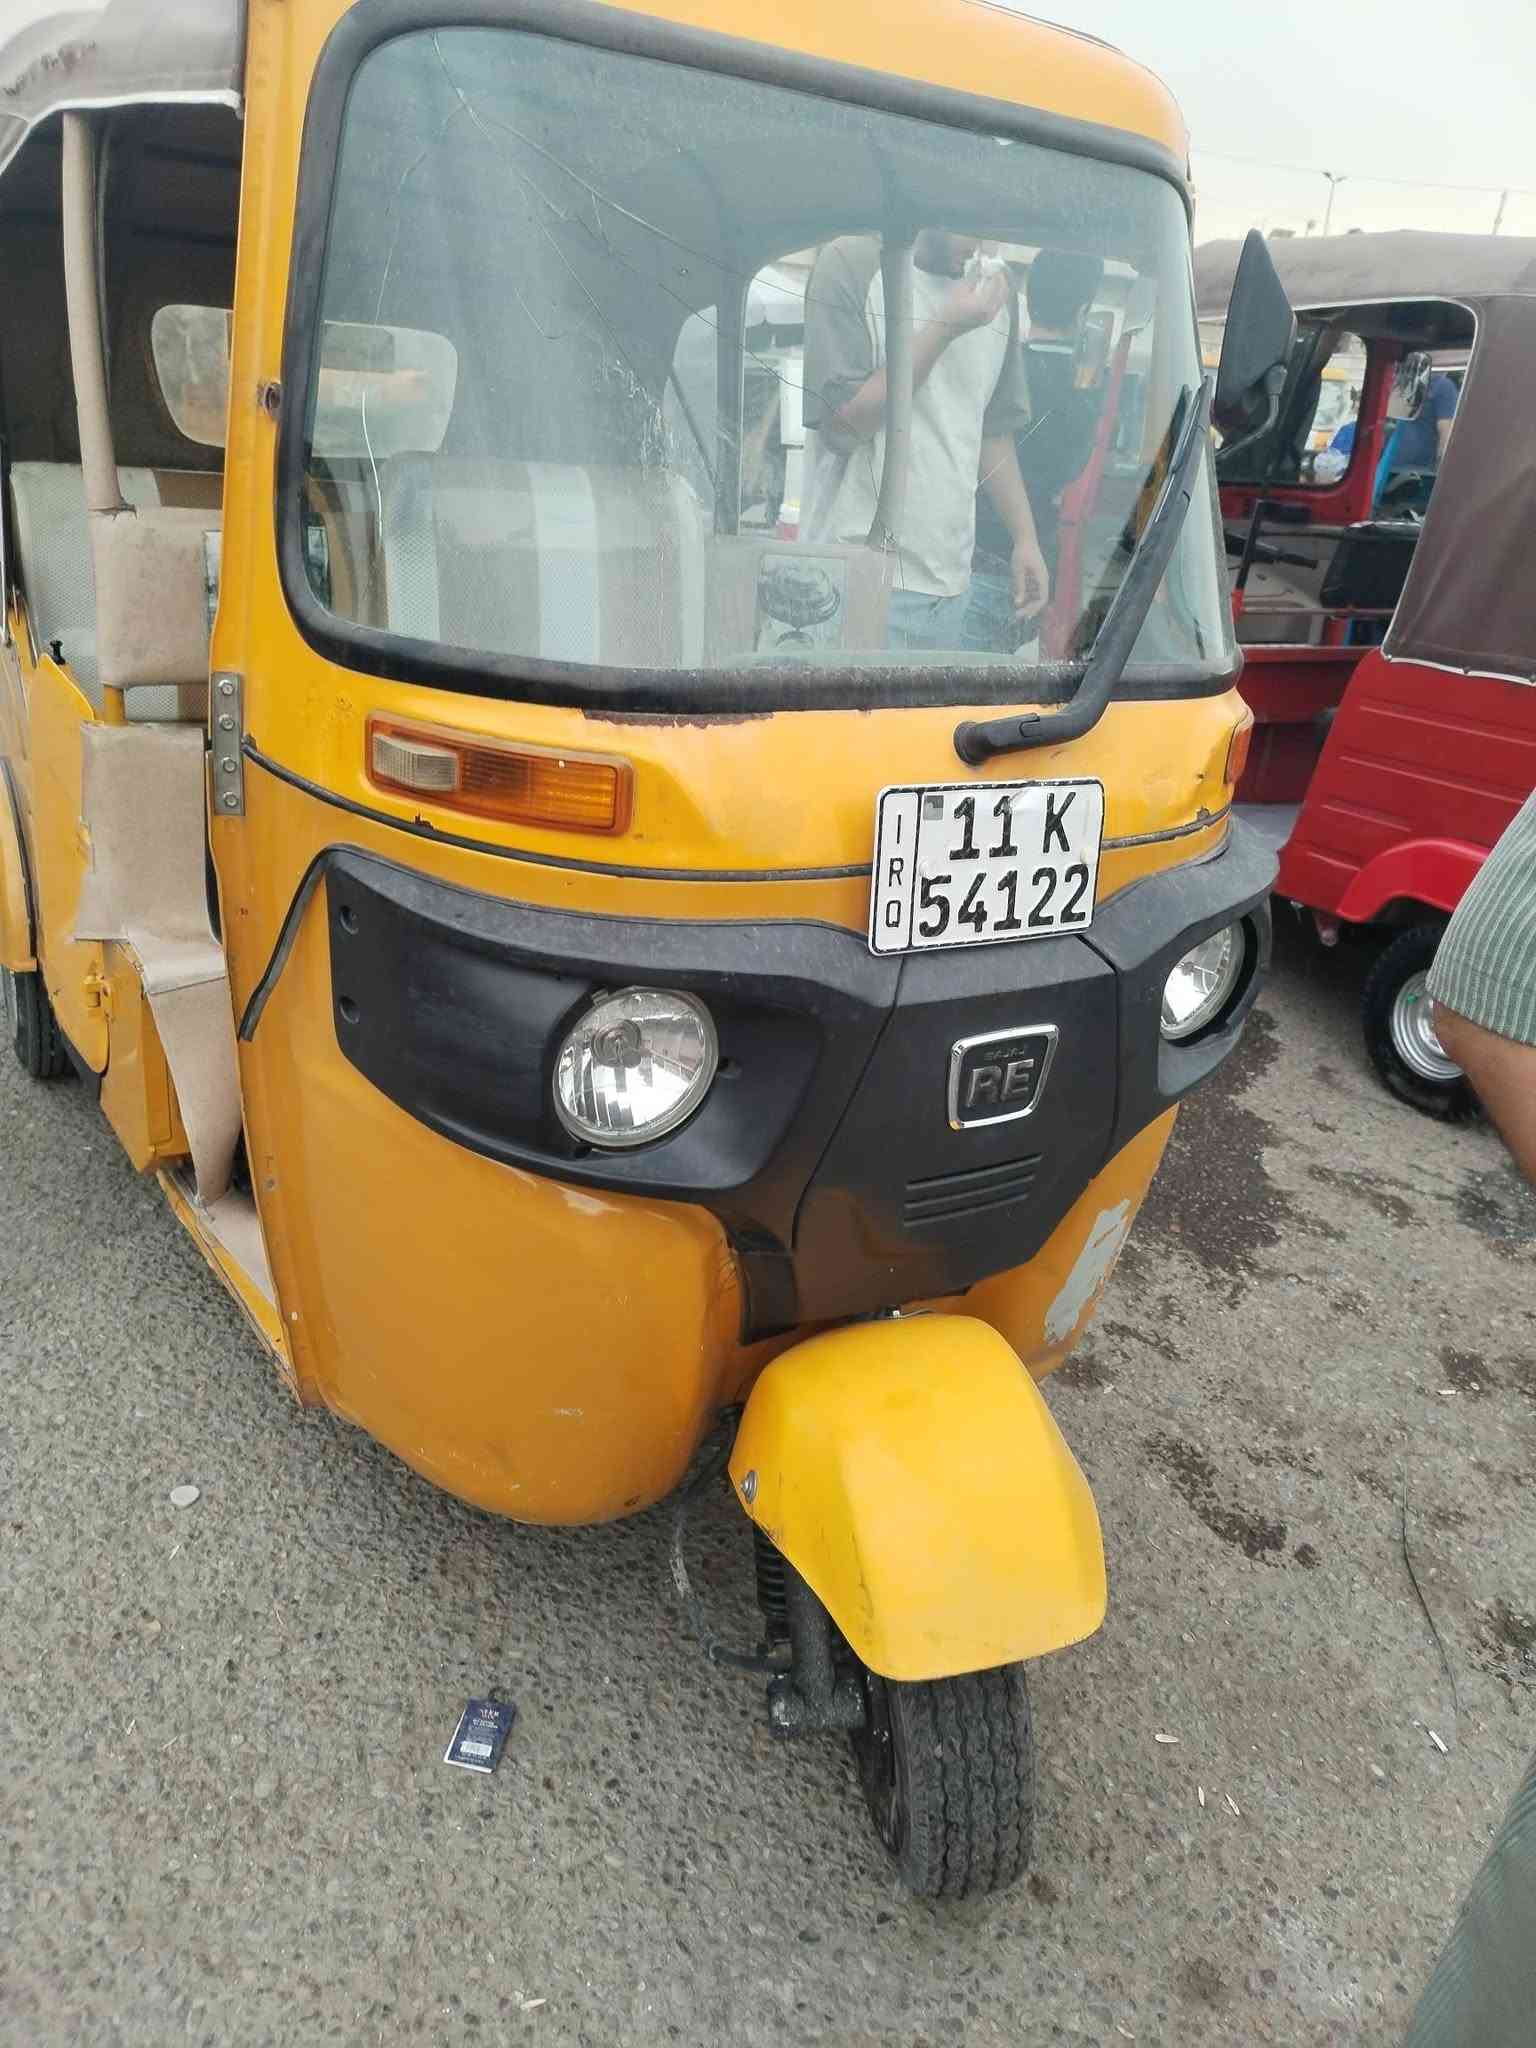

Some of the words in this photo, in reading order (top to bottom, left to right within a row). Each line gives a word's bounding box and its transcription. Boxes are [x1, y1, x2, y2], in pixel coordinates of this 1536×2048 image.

[949, 794, 1018, 860] 11
[1042, 791, 1076, 853] K
[885, 813, 905, 928] IRQ
[918, 863, 1089, 938] 54122
[966, 1057, 1034, 1108] RE
